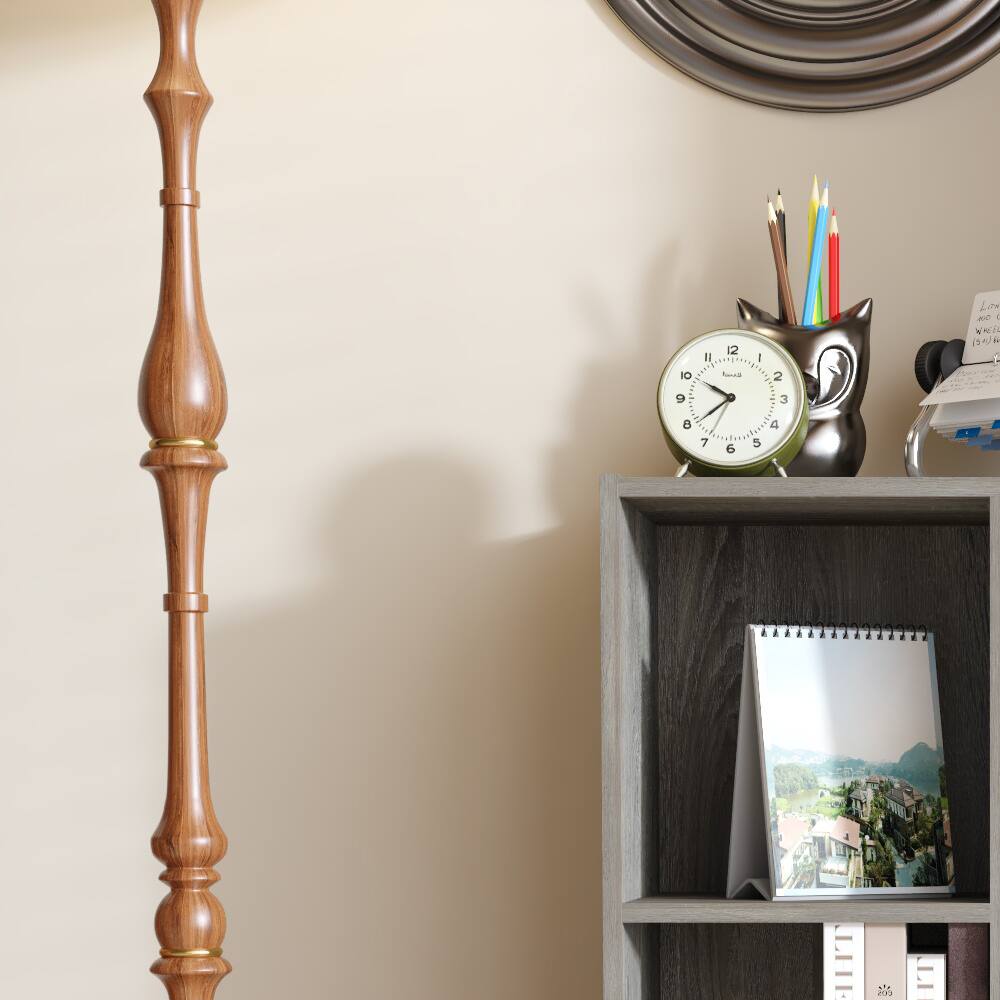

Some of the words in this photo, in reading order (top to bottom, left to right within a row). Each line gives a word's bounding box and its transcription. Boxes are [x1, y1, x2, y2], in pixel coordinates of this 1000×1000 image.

[727, 345, 739, 355] 12
[704, 352, 711, 362] 11
[680, 371, 692, 380] 10
[773, 371, 782, 381] 2
[676, 394, 686, 403] 9
[780, 395, 788, 404] 3
[683, 419, 691, 430] 8
[770, 419, 779, 430] 4
[700, 438, 709, 448] 7
[753, 438, 761, 448] 5
[726, 444, 735, 454] 6
